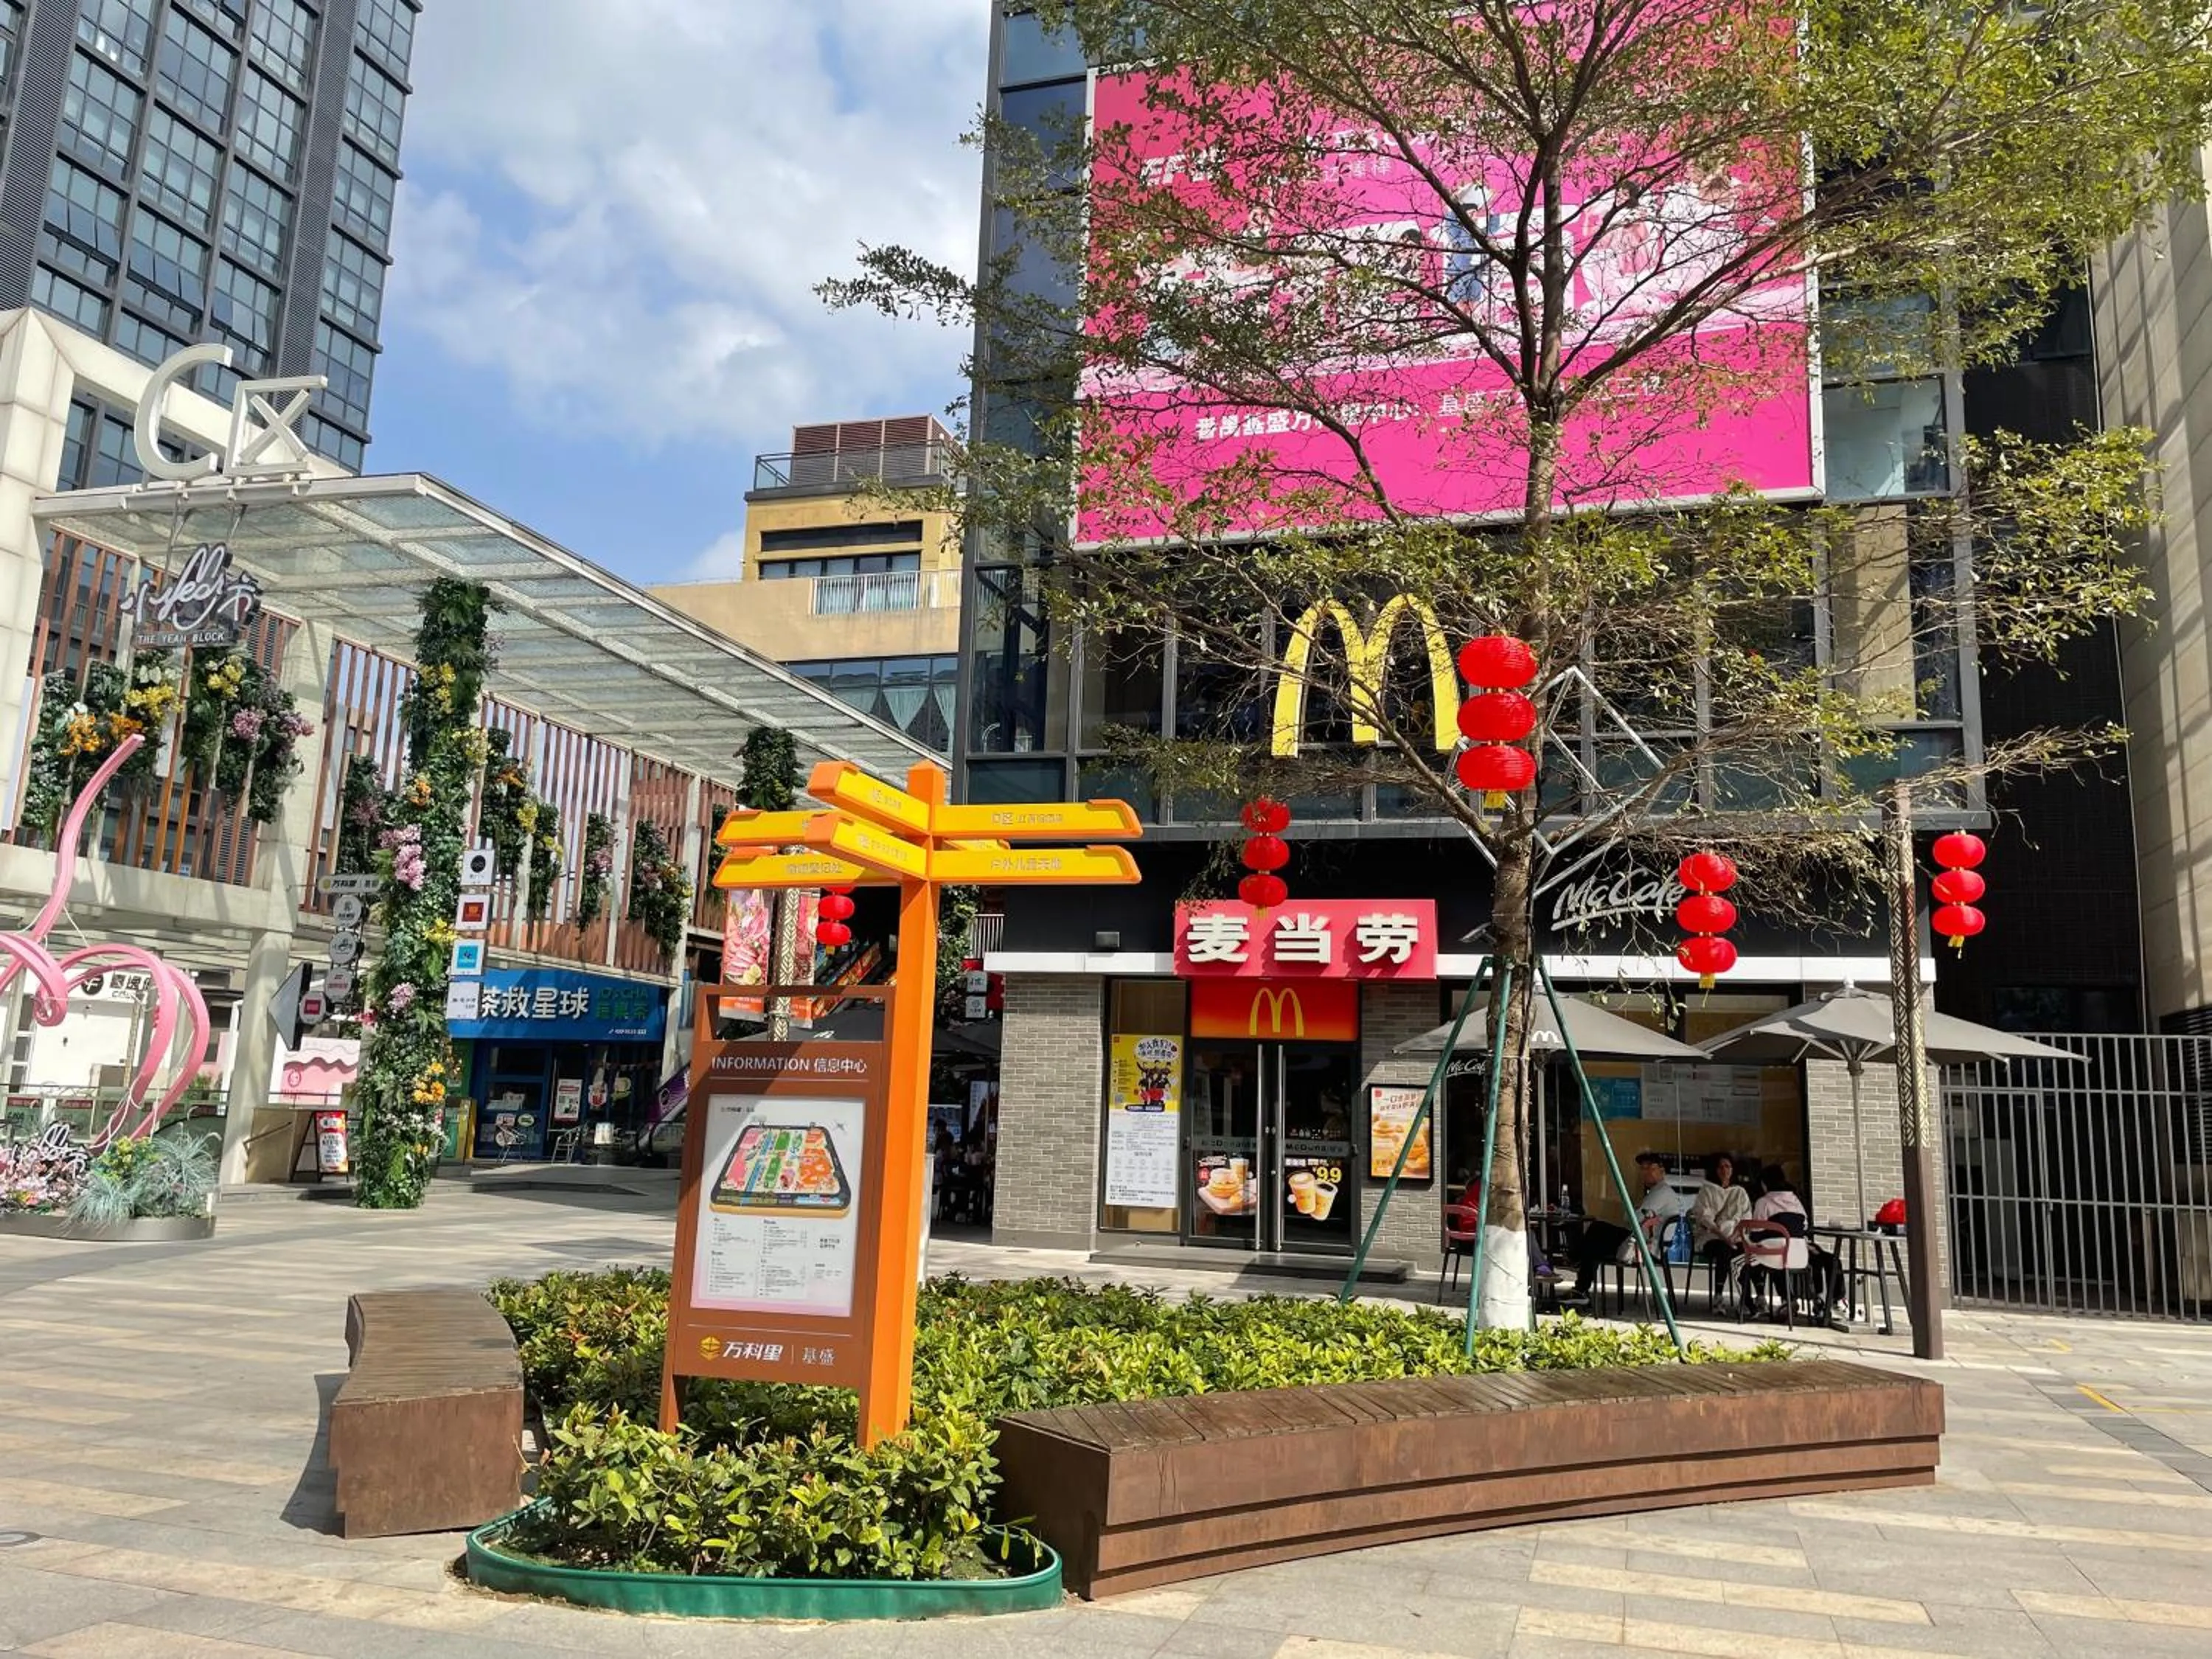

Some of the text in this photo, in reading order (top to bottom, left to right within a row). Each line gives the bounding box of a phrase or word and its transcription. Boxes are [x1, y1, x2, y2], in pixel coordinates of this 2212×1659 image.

[138, 636, 158, 644] THE
[192, 632, 224, 642] BLOCK
[1186, 913, 1419, 964] 麦当劳
[481, 985, 589, 1019] 茶救星球
[712, 1056, 867, 1074] INFORMATION 信息中心
[723, 1341, 835, 1366] 万科里 基盛
